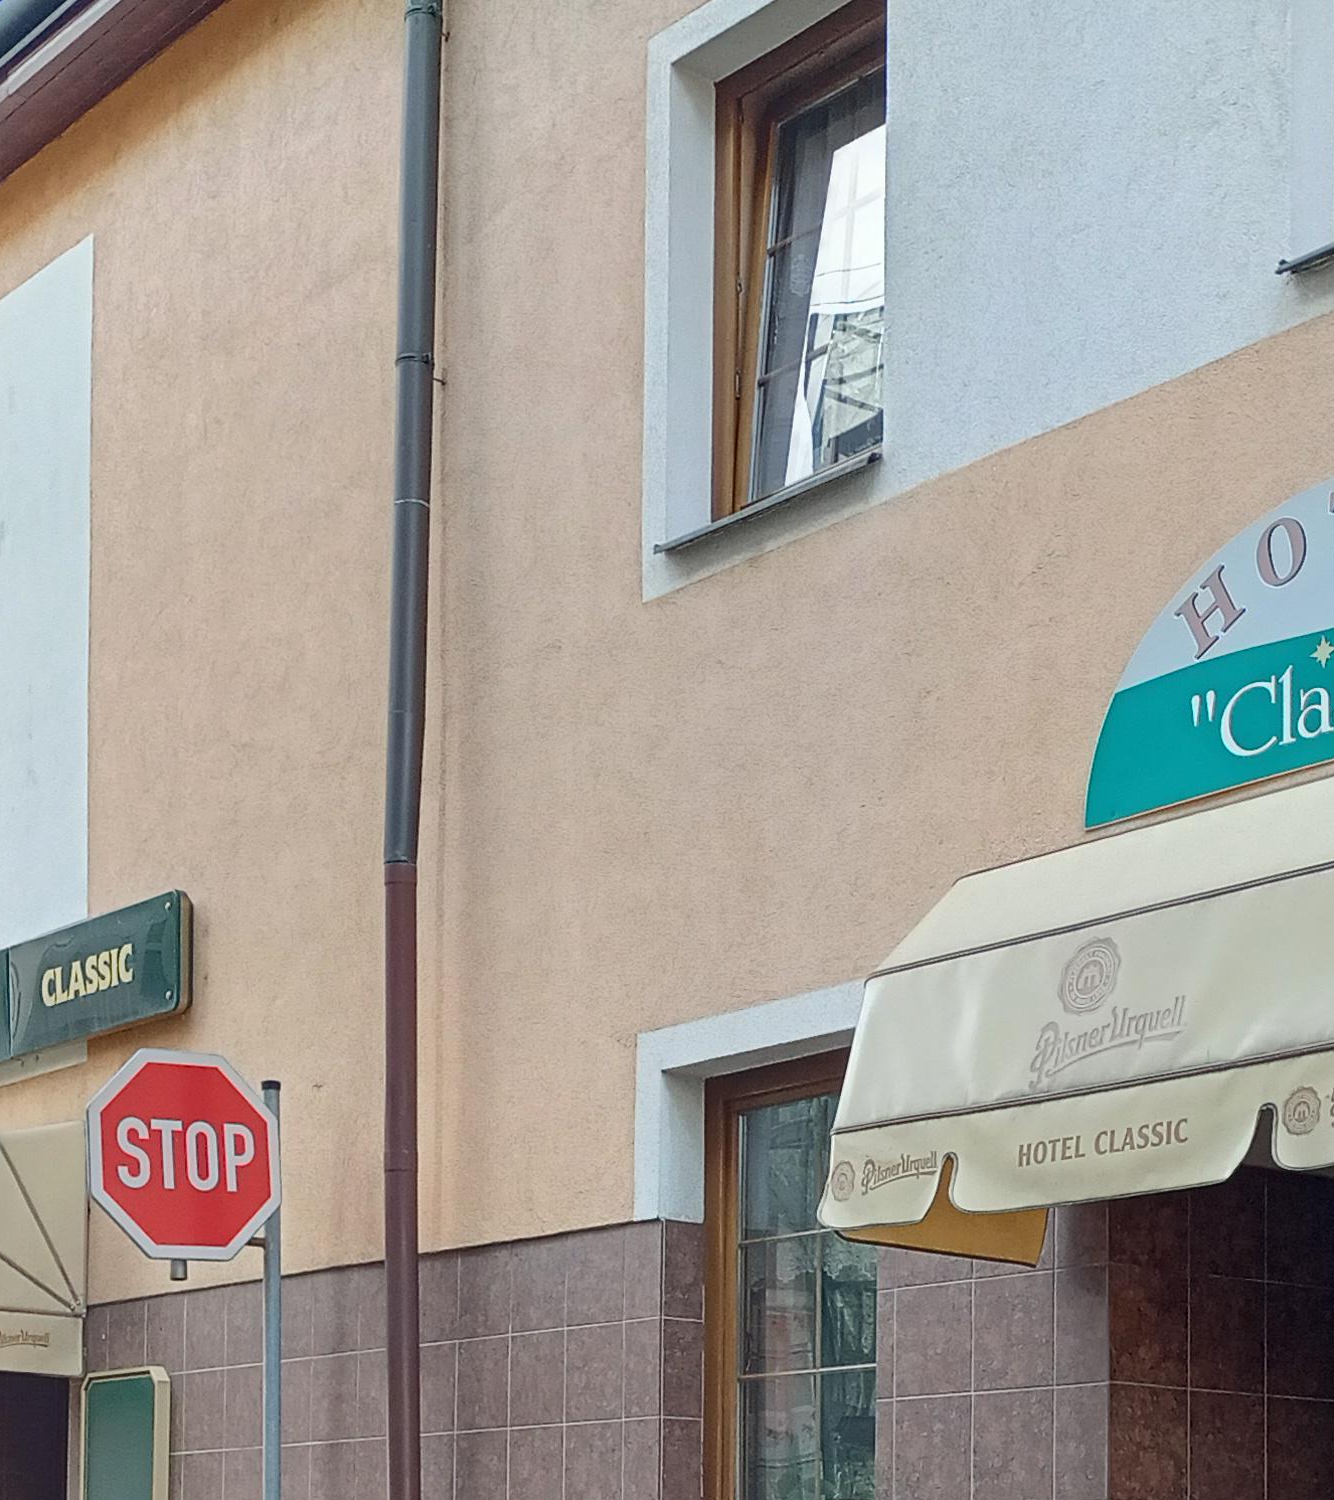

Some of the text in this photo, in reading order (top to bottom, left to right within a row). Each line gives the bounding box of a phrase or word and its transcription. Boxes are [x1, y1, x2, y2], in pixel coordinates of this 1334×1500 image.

[40, 943, 135, 1008] CLASSIC
[1028, 995, 1187, 1090] Pilsner Urquell
[116, 1116, 255, 1193] STOP
[861, 1150, 938, 1196] Pilsner Urquell
[1018, 1118, 1189, 1168] HOTEL CLASSIC
